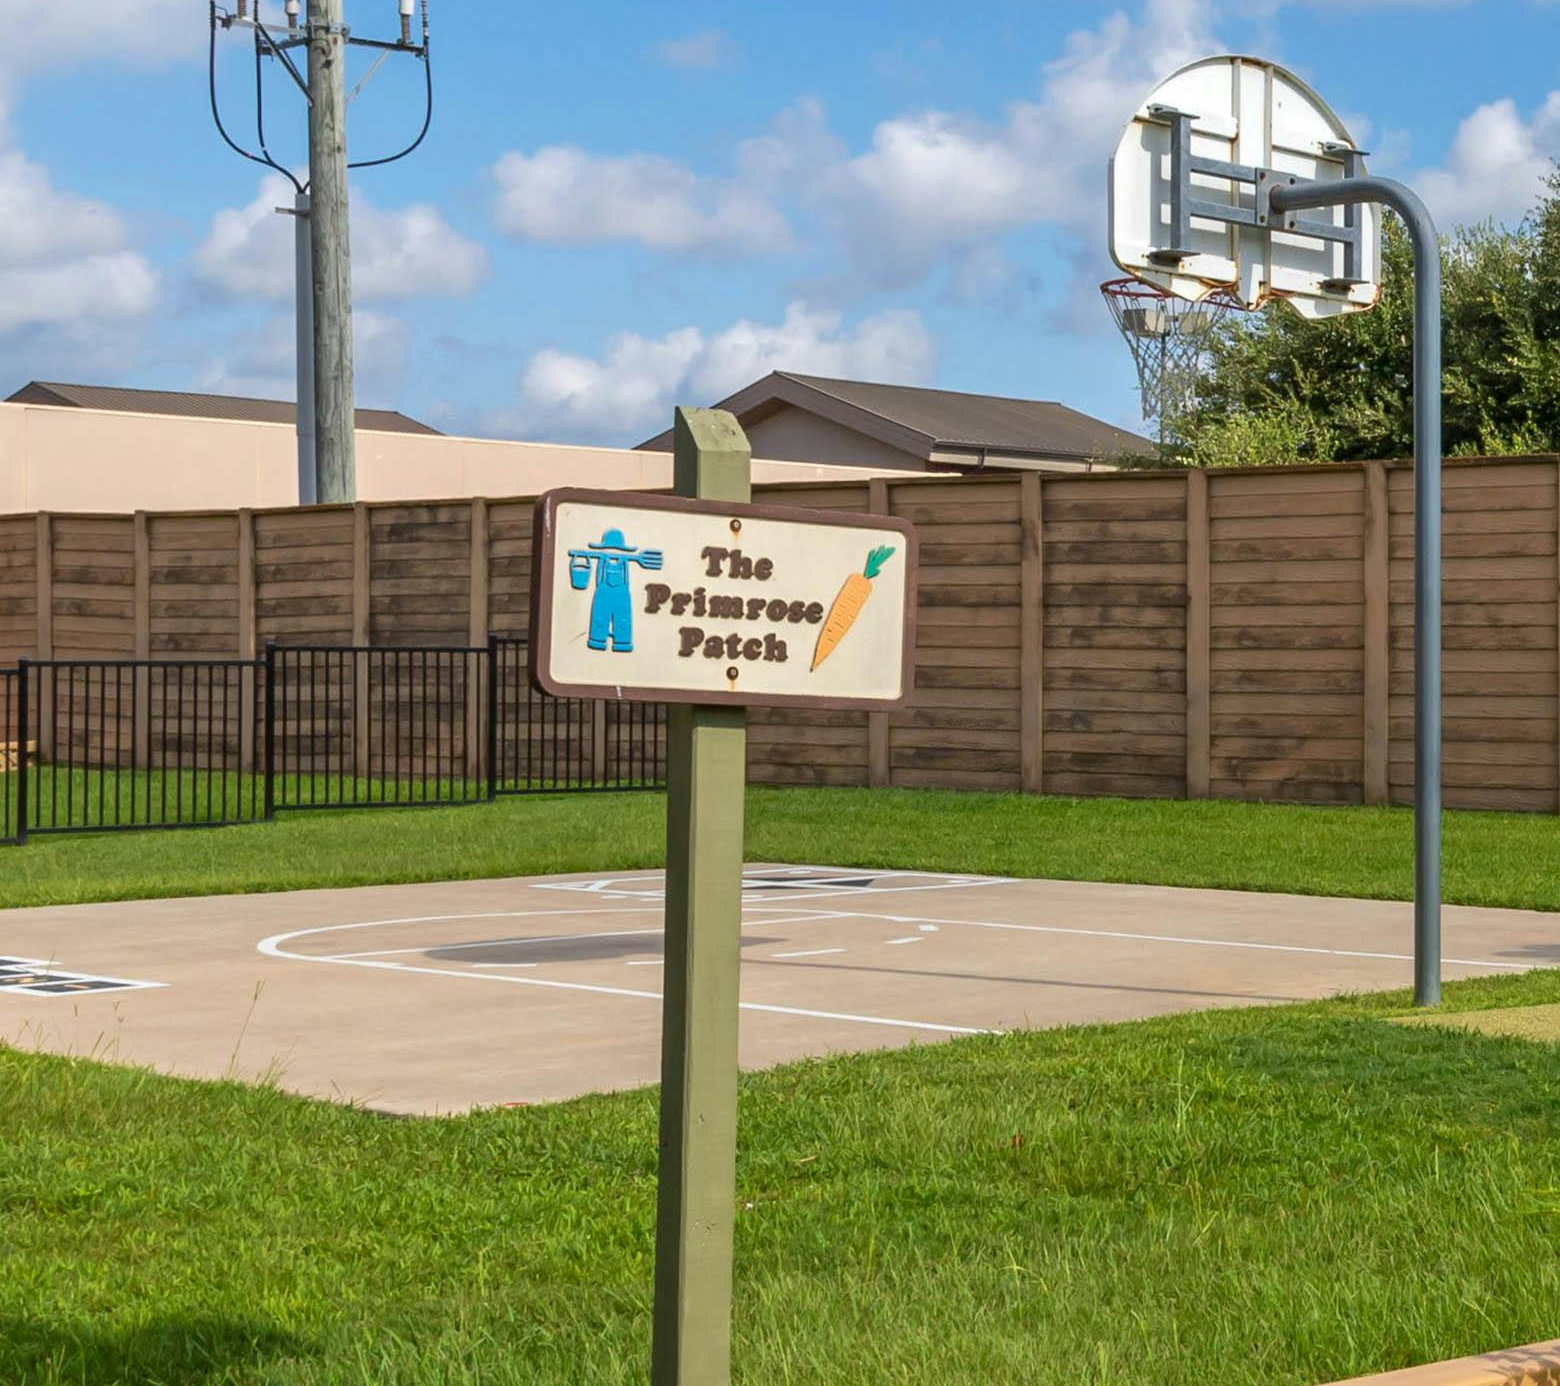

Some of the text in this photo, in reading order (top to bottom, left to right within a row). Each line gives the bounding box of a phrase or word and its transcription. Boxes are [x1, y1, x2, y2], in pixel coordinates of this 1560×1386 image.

[701, 546, 774, 581] The
[644, 583, 824, 624] Primrose
[678, 626, 788, 663] Patch
